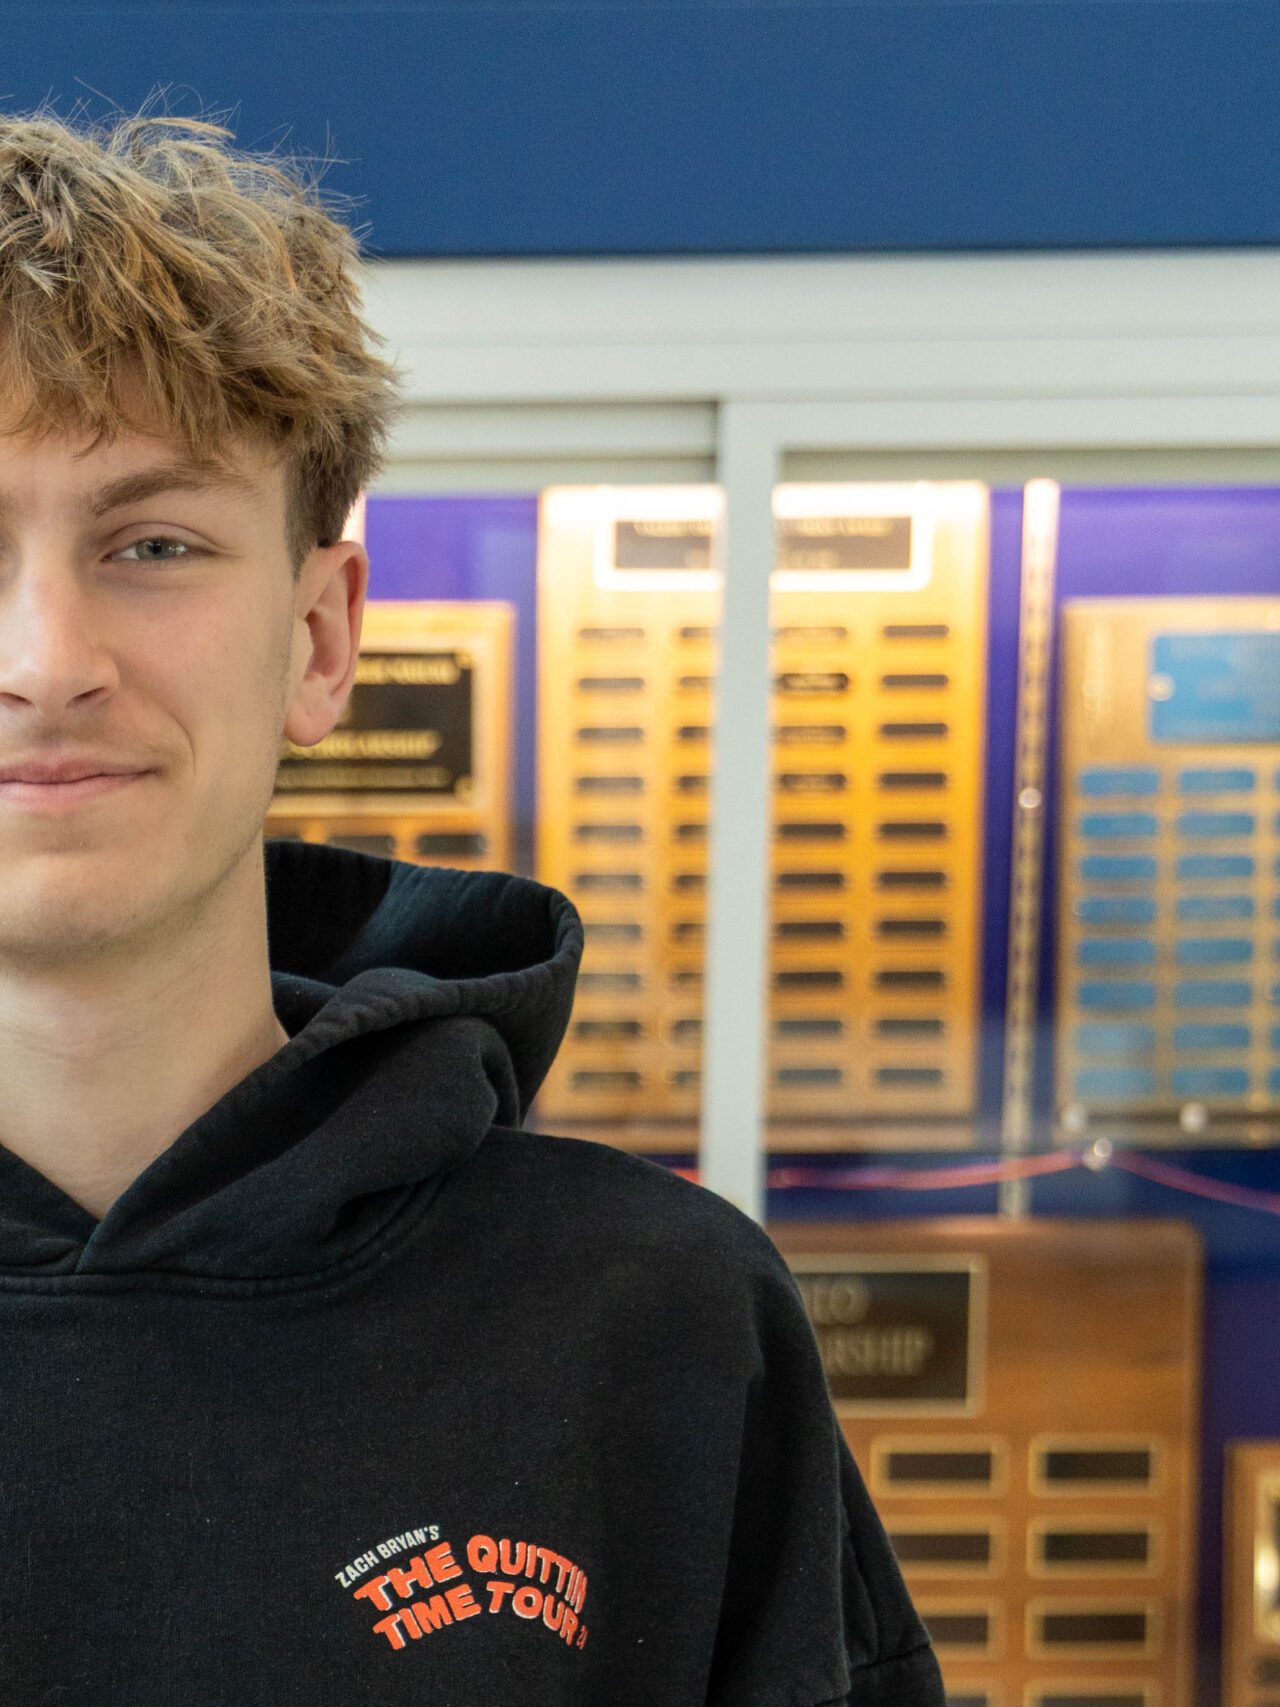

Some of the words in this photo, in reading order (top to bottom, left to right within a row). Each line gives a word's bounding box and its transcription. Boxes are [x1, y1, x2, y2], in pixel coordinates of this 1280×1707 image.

[335, 1550, 380, 1588] ZACH
[376, 1525, 440, 1560] BRYAN'S
[353, 1541, 463, 1611] THE
[466, 1534, 588, 1614] QUITTIN
[372, 1583, 482, 1651] TIME
[486, 1581, 579, 1646] TOUR
